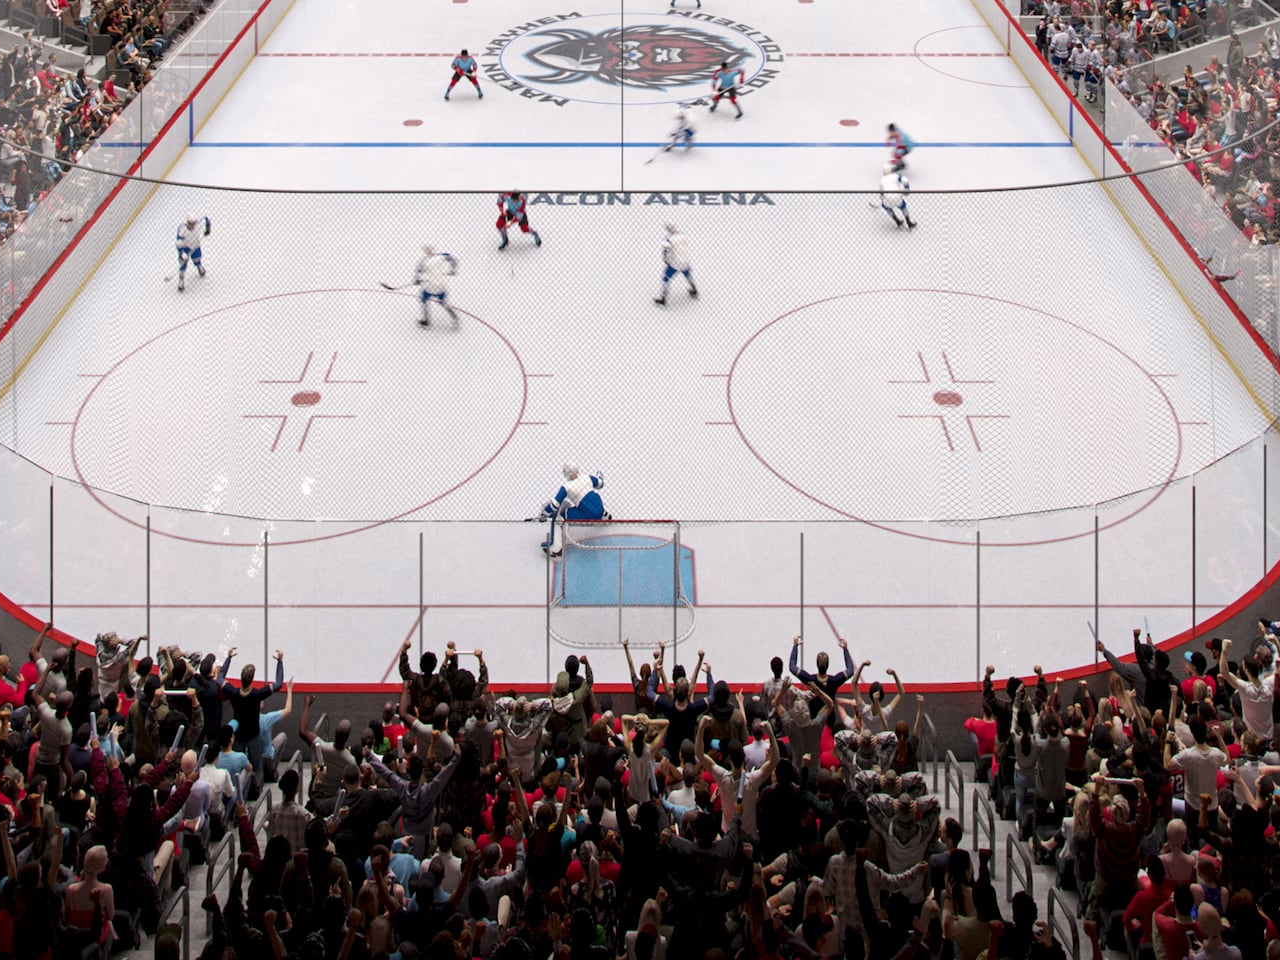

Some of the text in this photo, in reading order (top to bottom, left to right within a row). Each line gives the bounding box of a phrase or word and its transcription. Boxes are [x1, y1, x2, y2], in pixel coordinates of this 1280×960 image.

[482, 11, 583, 107] MACON MAYHEM
[667, 9, 784, 63] COLISEUM
[643, 192, 777, 206] ARENA
